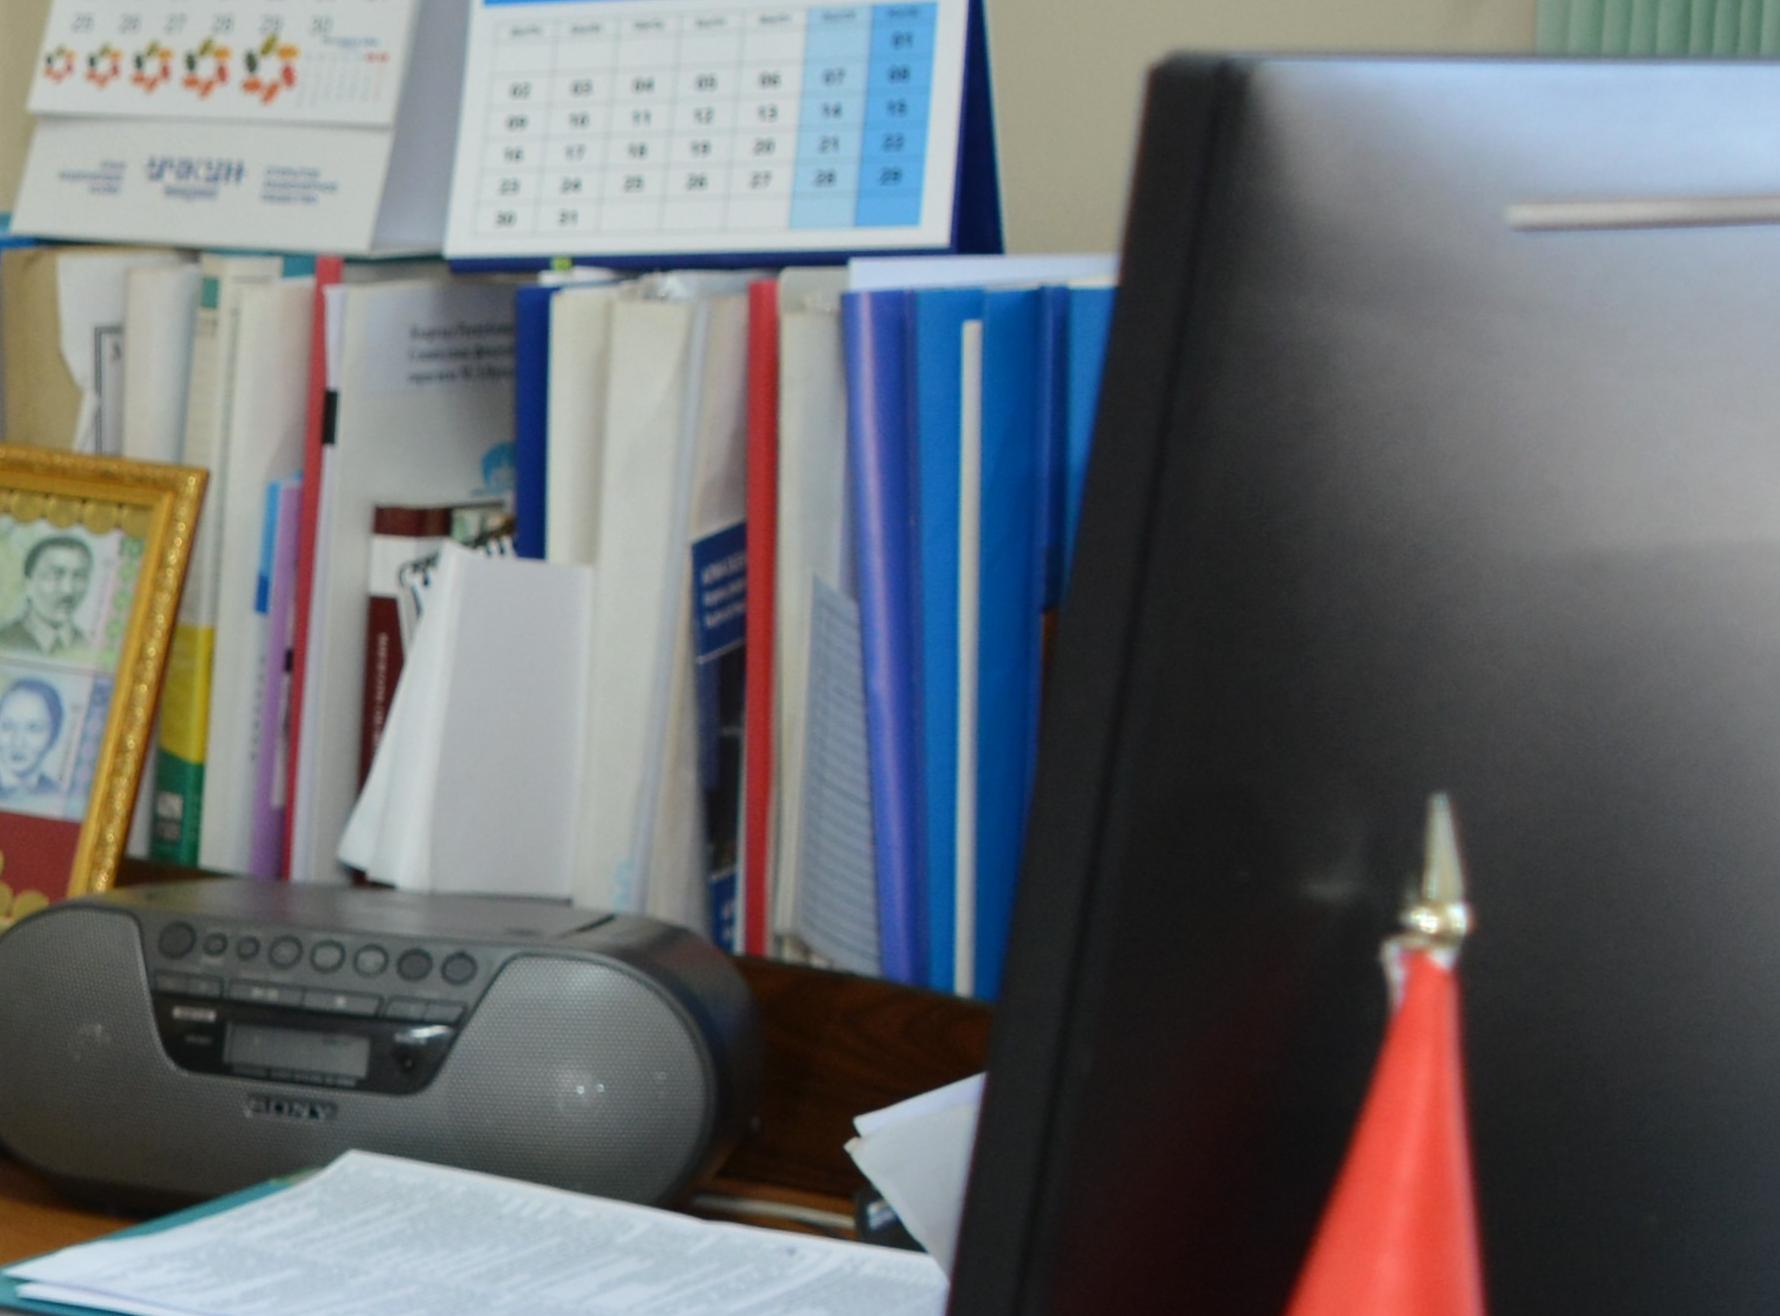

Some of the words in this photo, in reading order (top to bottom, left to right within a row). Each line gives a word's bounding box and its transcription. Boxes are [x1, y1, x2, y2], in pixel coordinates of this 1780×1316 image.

[892, 33, 912, 49] 01
[510, 83, 530, 98] 02
[571, 81, 592, 96] 03
[633, 79, 654, 92] 04
[696, 75, 716, 90] 05
[760, 74, 780, 87] 06
[823, 69, 845, 85] 07
[889, 67, 910, 81] 08
[507, 116, 527, 129] 09
[570, 113, 589, 127] 10
[632, 110, 651, 124] 11
[694, 107, 714, 124] 12
[758, 105, 778, 121] 13
[823, 104, 842, 117] 14
[887, 100, 907, 115] 15
[505, 149, 523, 162] 16
[565, 144, 585, 159] 17
[629, 144, 647, 158] 18
[691, 142, 710, 155] 19
[754, 139, 775, 155] 20
[819, 136, 839, 153] 21
[882, 134, 904, 152] 22
[499, 179, 520, 195] 23
[561, 179, 581, 193] 24
[624, 176, 644, 192] 25
[687, 175, 706, 190] 26
[750, 171, 771, 189] 27
[816, 171, 836, 186] 28
[880, 169, 902, 185] 29
[497, 213, 515, 226] 30
[559, 210, 578, 225] 31
[245, 1096, 341, 1121] SONY
